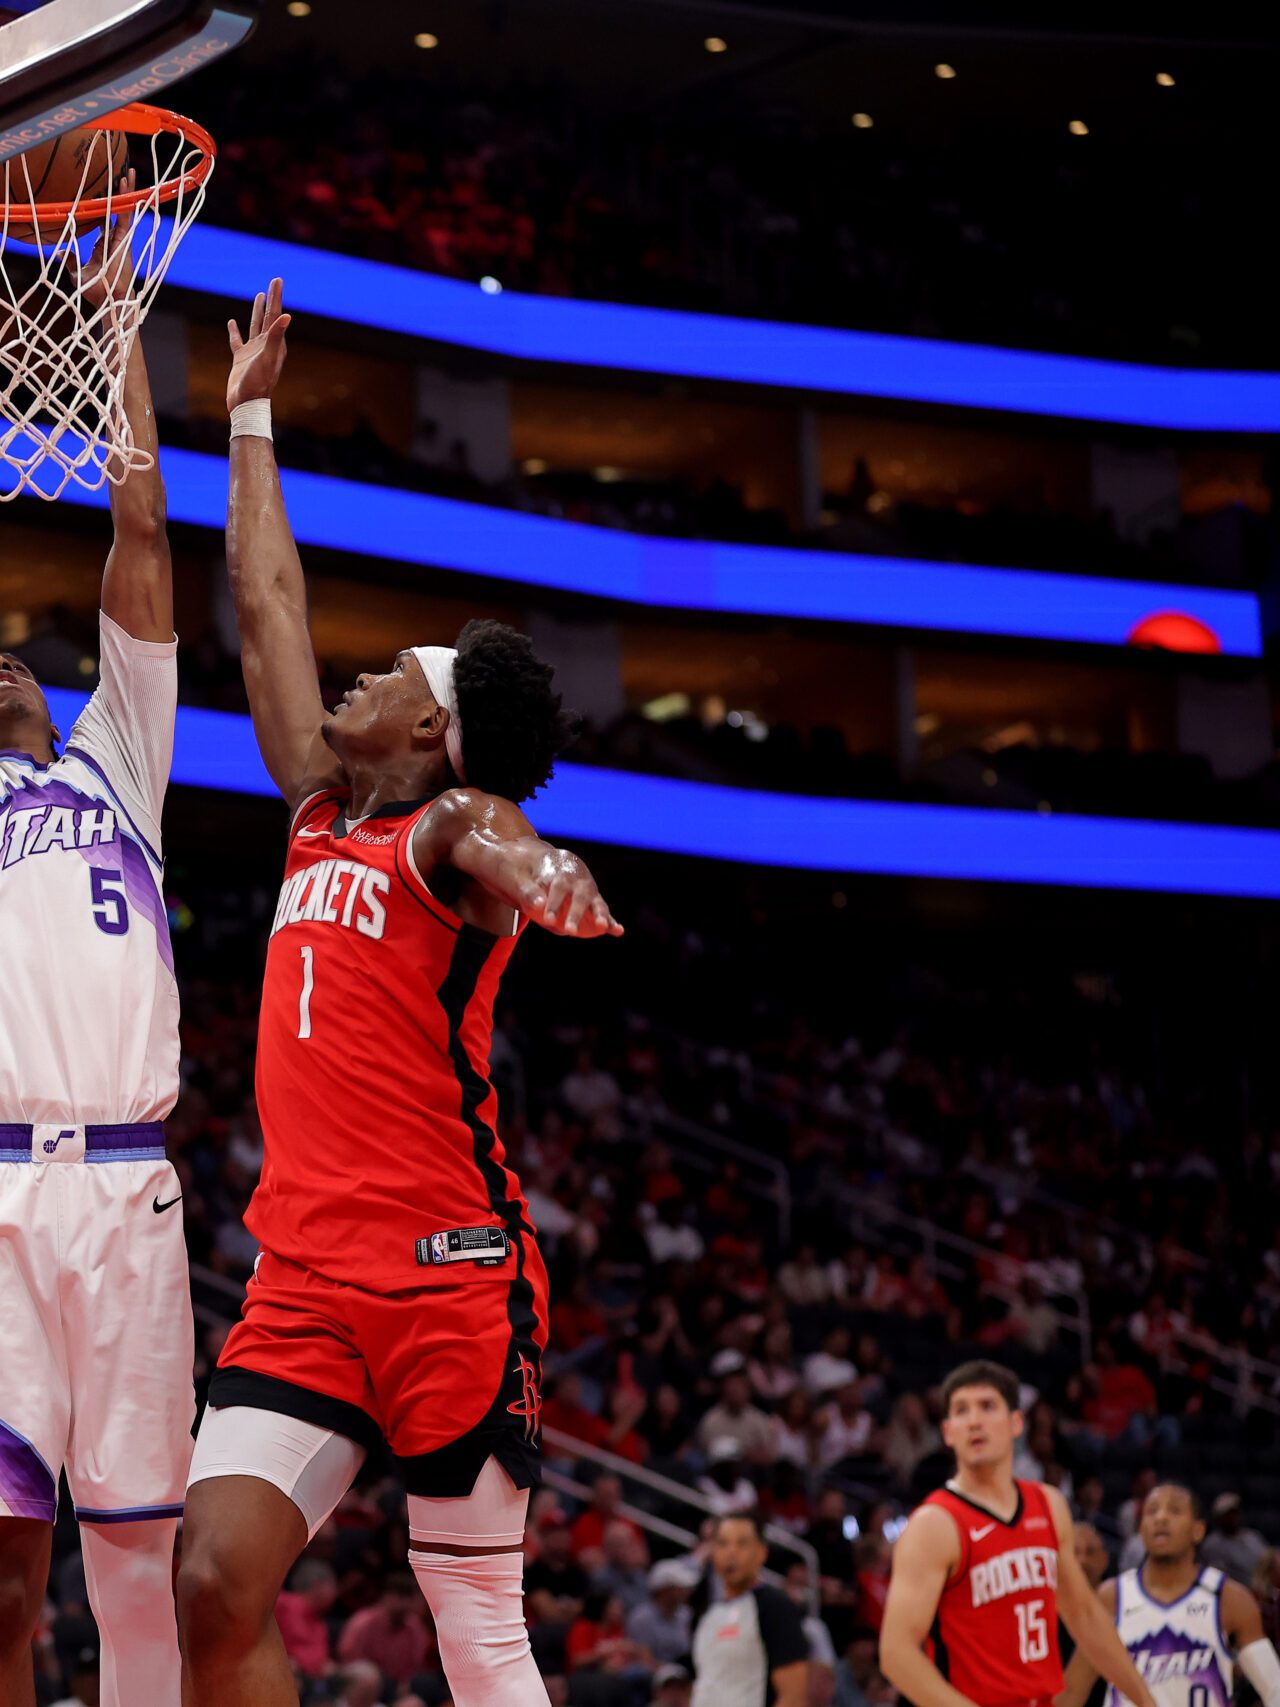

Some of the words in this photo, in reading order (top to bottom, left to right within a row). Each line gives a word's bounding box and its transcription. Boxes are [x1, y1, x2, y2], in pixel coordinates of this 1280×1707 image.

[89, 866, 130, 936] 5
[297, 945, 314, 1039] 1
[1014, 1599, 1049, 1664] 15
